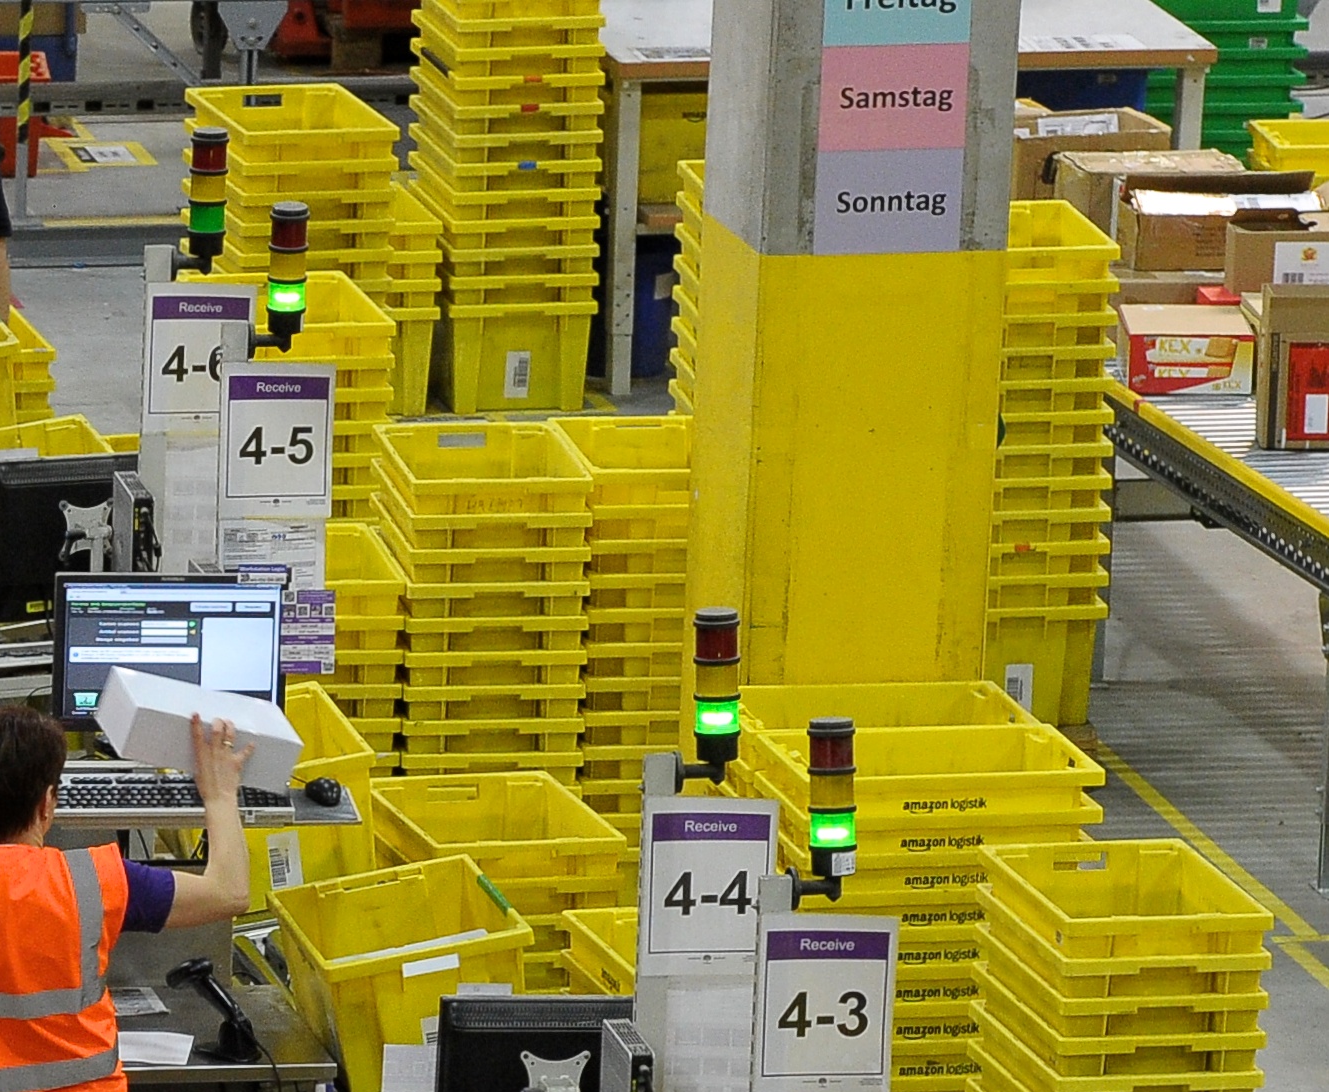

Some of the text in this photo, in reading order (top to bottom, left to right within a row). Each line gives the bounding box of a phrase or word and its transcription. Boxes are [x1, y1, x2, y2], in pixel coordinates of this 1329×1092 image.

[840, 87, 954, 112] Samstag
[836, 191, 947, 216] Sonntag
[178, 302, 223, 312] Receive
[256, 382, 301, 393] Receive
[239, 427, 314, 465] 4-5
[903, 798, 987, 813] amazon logistik
[684, 820, 738, 833] Receive
[901, 835, 985, 851] amazon logistik
[905, 872, 988, 889] amazon logistik
[664, 871, 753, 915] 4-4
[902, 909, 985, 926] amazon logistik
[800, 938, 856, 951] Receive
[897, 947, 980, 964] amazon logistik
[896, 985, 979, 1001] amazon logistik
[778, 992, 869, 1038] 4-3
[896, 1022, 979, 1040] amazon logistik
[899, 1062, 982, 1078] amazon logistik
